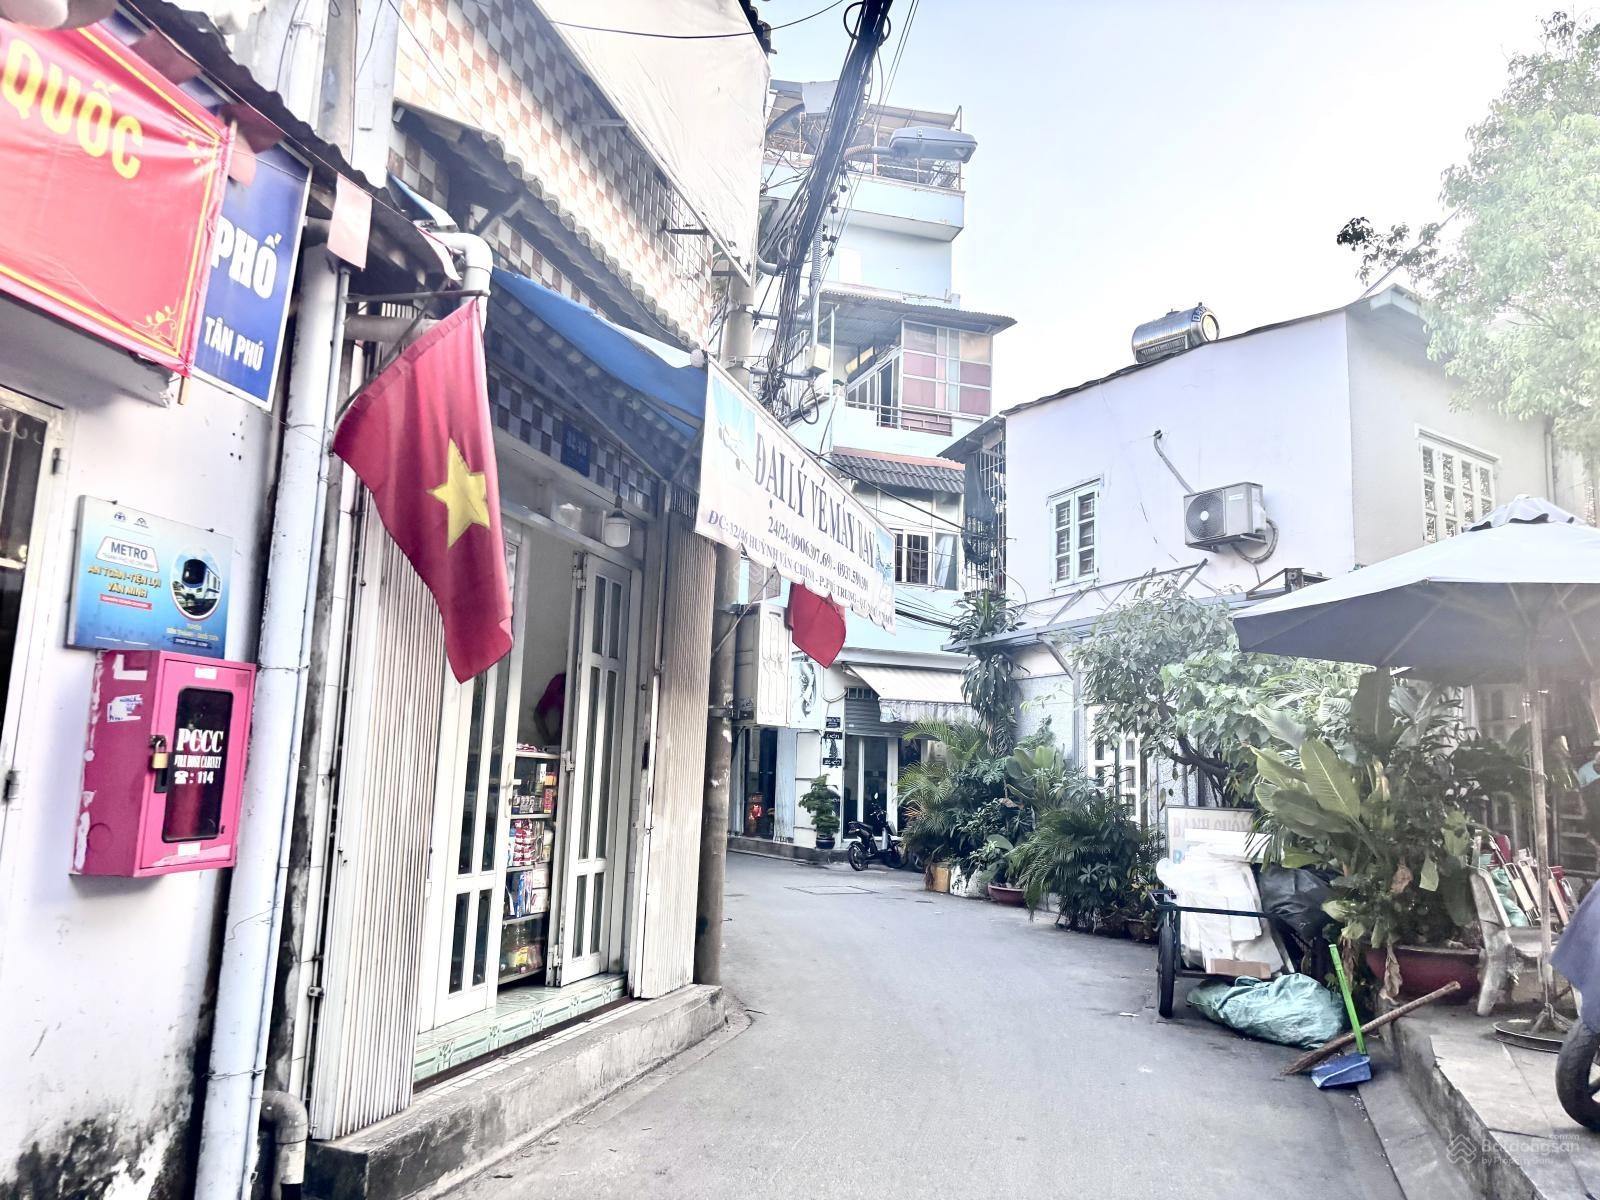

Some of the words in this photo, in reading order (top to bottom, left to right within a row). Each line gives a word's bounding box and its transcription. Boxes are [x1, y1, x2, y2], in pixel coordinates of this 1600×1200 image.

[2, 38, 143, 179] QUỐC
[210, 215, 282, 299] PHỐ
[204, 316, 234, 356] TÂN
[234, 334, 264, 371] PHÚ
[111, 541, 148, 560] METRO
[176, 728, 224, 753] PCCC
[197, 771, 214, 784] 114
